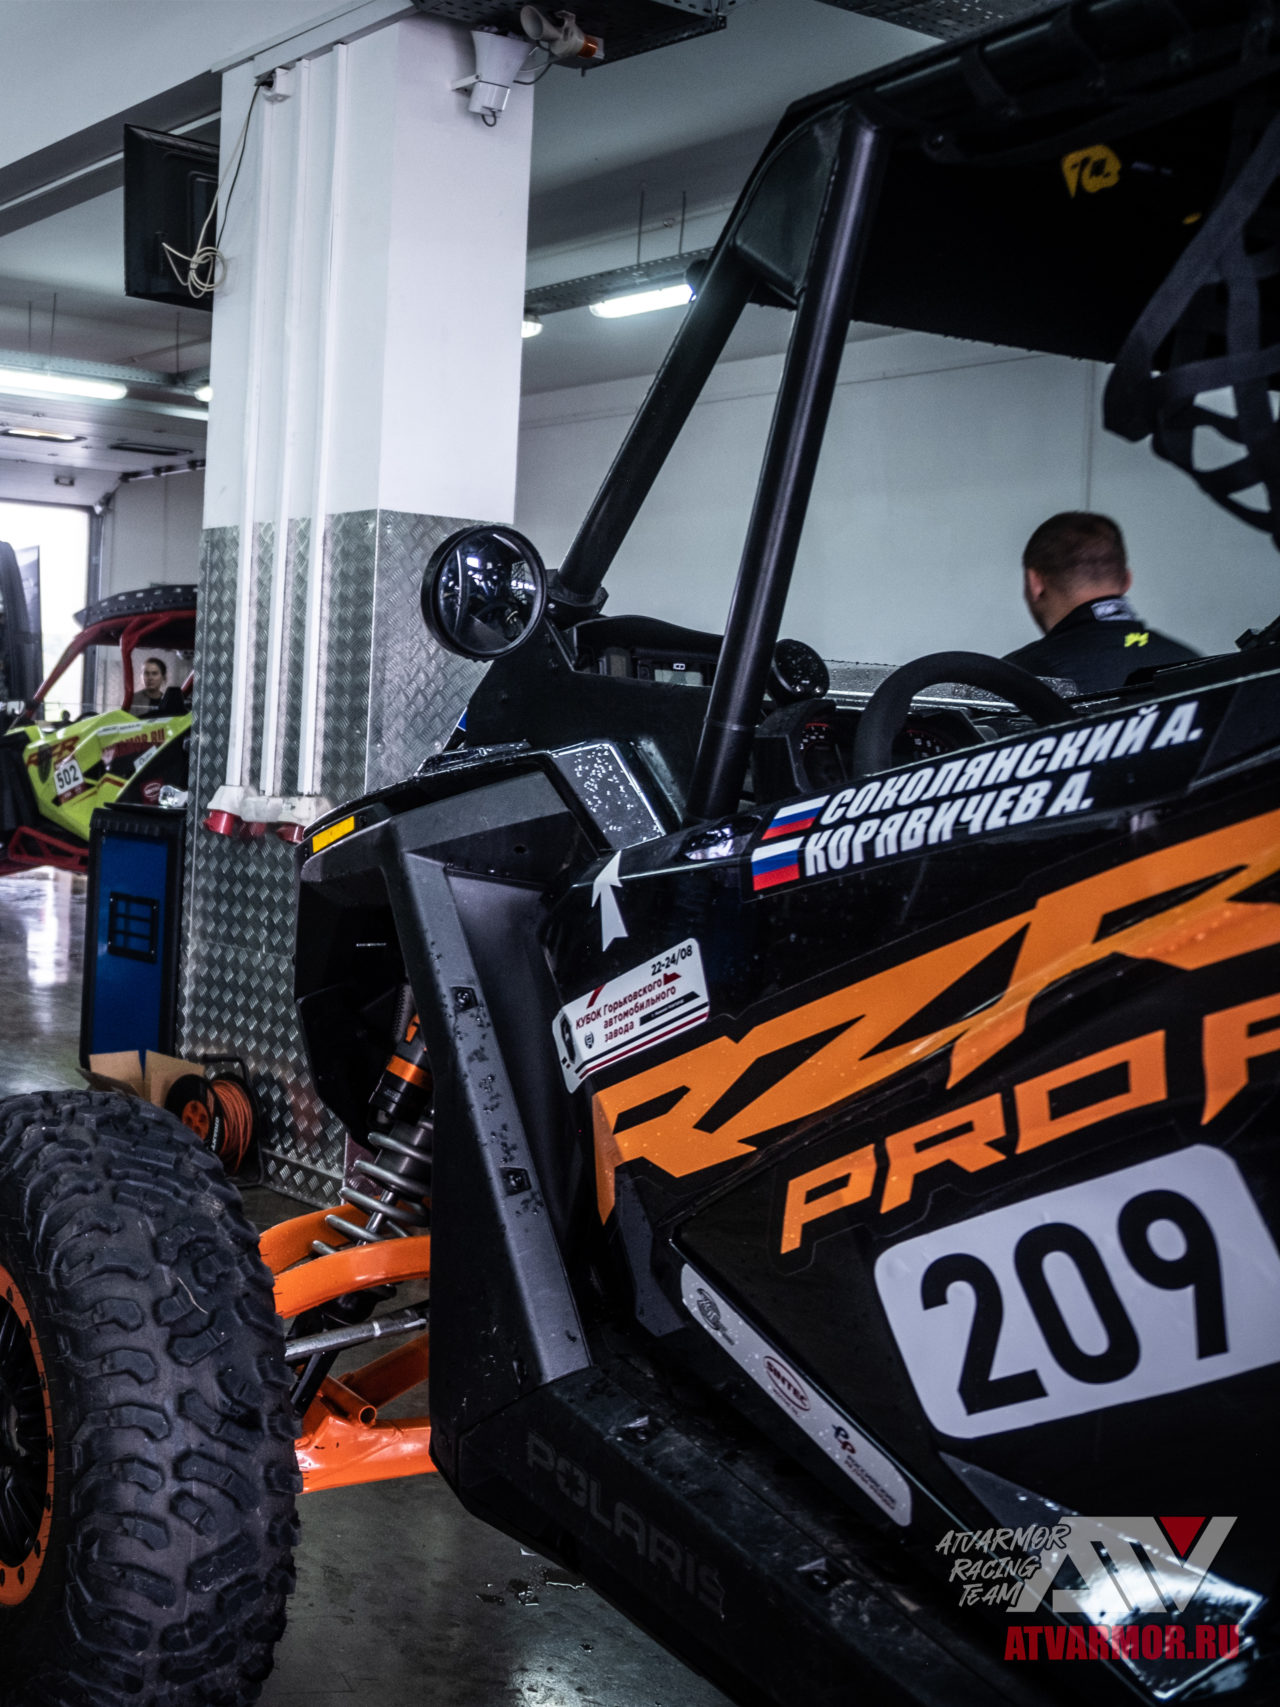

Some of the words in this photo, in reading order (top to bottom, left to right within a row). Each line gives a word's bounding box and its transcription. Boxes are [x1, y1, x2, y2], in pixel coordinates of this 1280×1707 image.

[56, 764, 79, 789] 502
[820, 705, 1159, 825] СОКОЛЯНСКИЙ
[805, 781, 1053, 877] КОРЯВИЧЕВ
[651, 945, 693, 976] 22-24/08
[575, 1009, 602, 1030] КУБОК
[603, 978, 663, 1015] Горьковского
[593, 808, 1280, 1226] RZR
[603, 986, 676, 1029] автомобильного
[604, 1021, 635, 1043] завода
[920, 1189, 1229, 1416] 209
[527, 1431, 725, 1614] POLARIS
